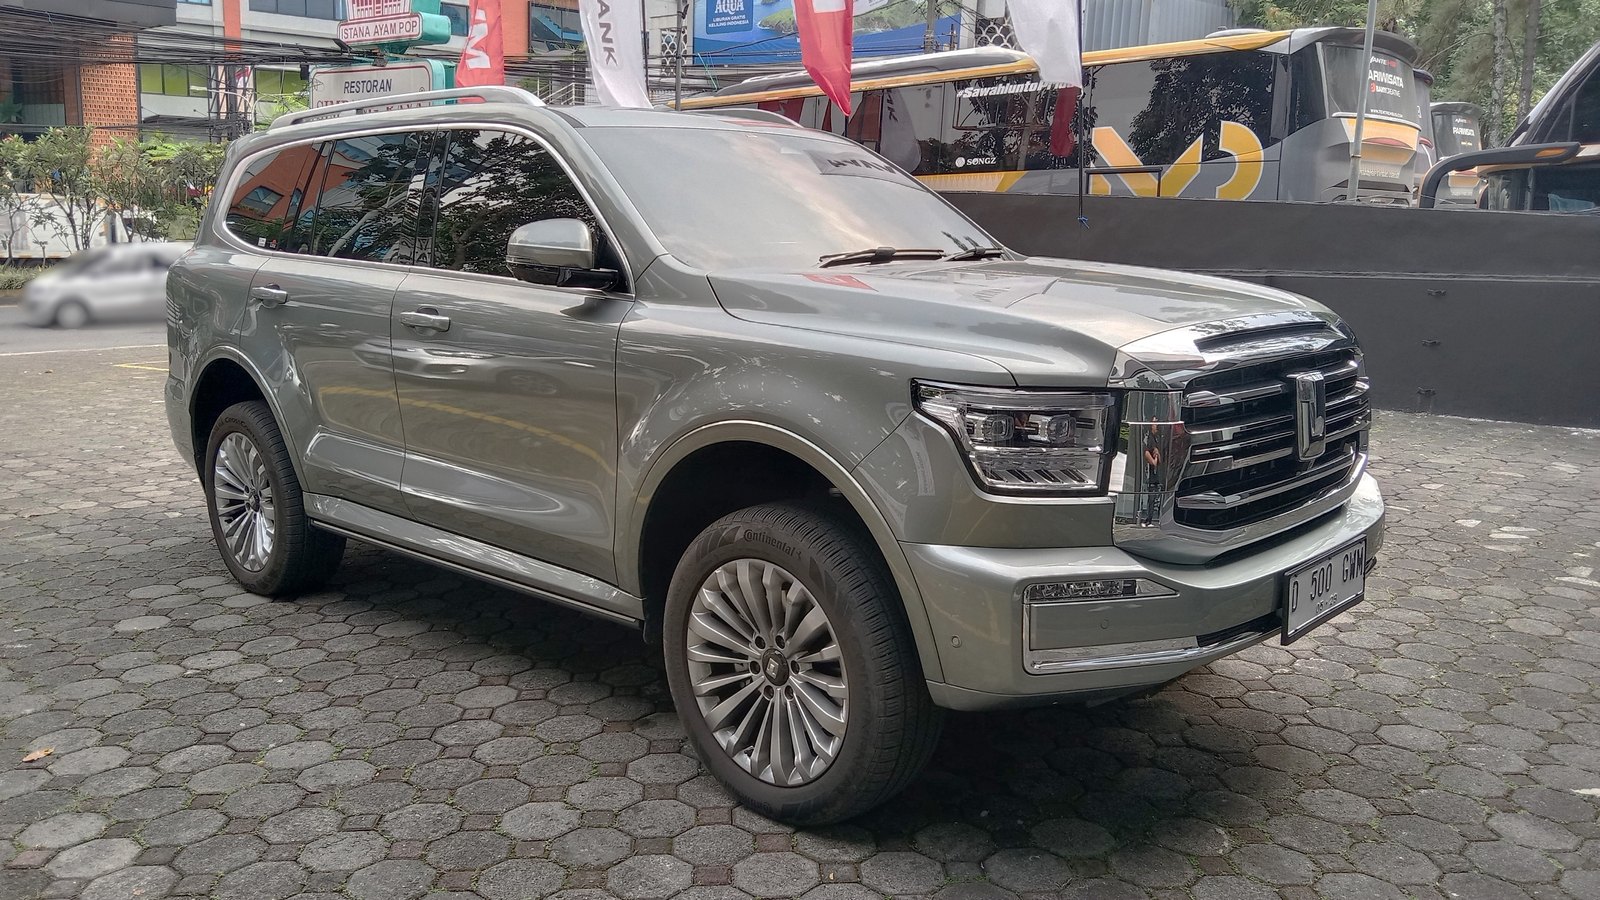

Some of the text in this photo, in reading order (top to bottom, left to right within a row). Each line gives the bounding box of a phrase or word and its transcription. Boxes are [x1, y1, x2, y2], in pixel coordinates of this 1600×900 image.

[715, 0, 745, 14] AQUA
[341, 20, 418, 39] ISTANA AYAM POP
[343, 79, 392, 94] RESTORAN
[1367, 70, 1404, 88] ARIWISATA
[966, 157, 997, 165] SONGZ
[743, 529, 796, 557] Continental
[1292, 547, 1364, 612] D 500 GWM
